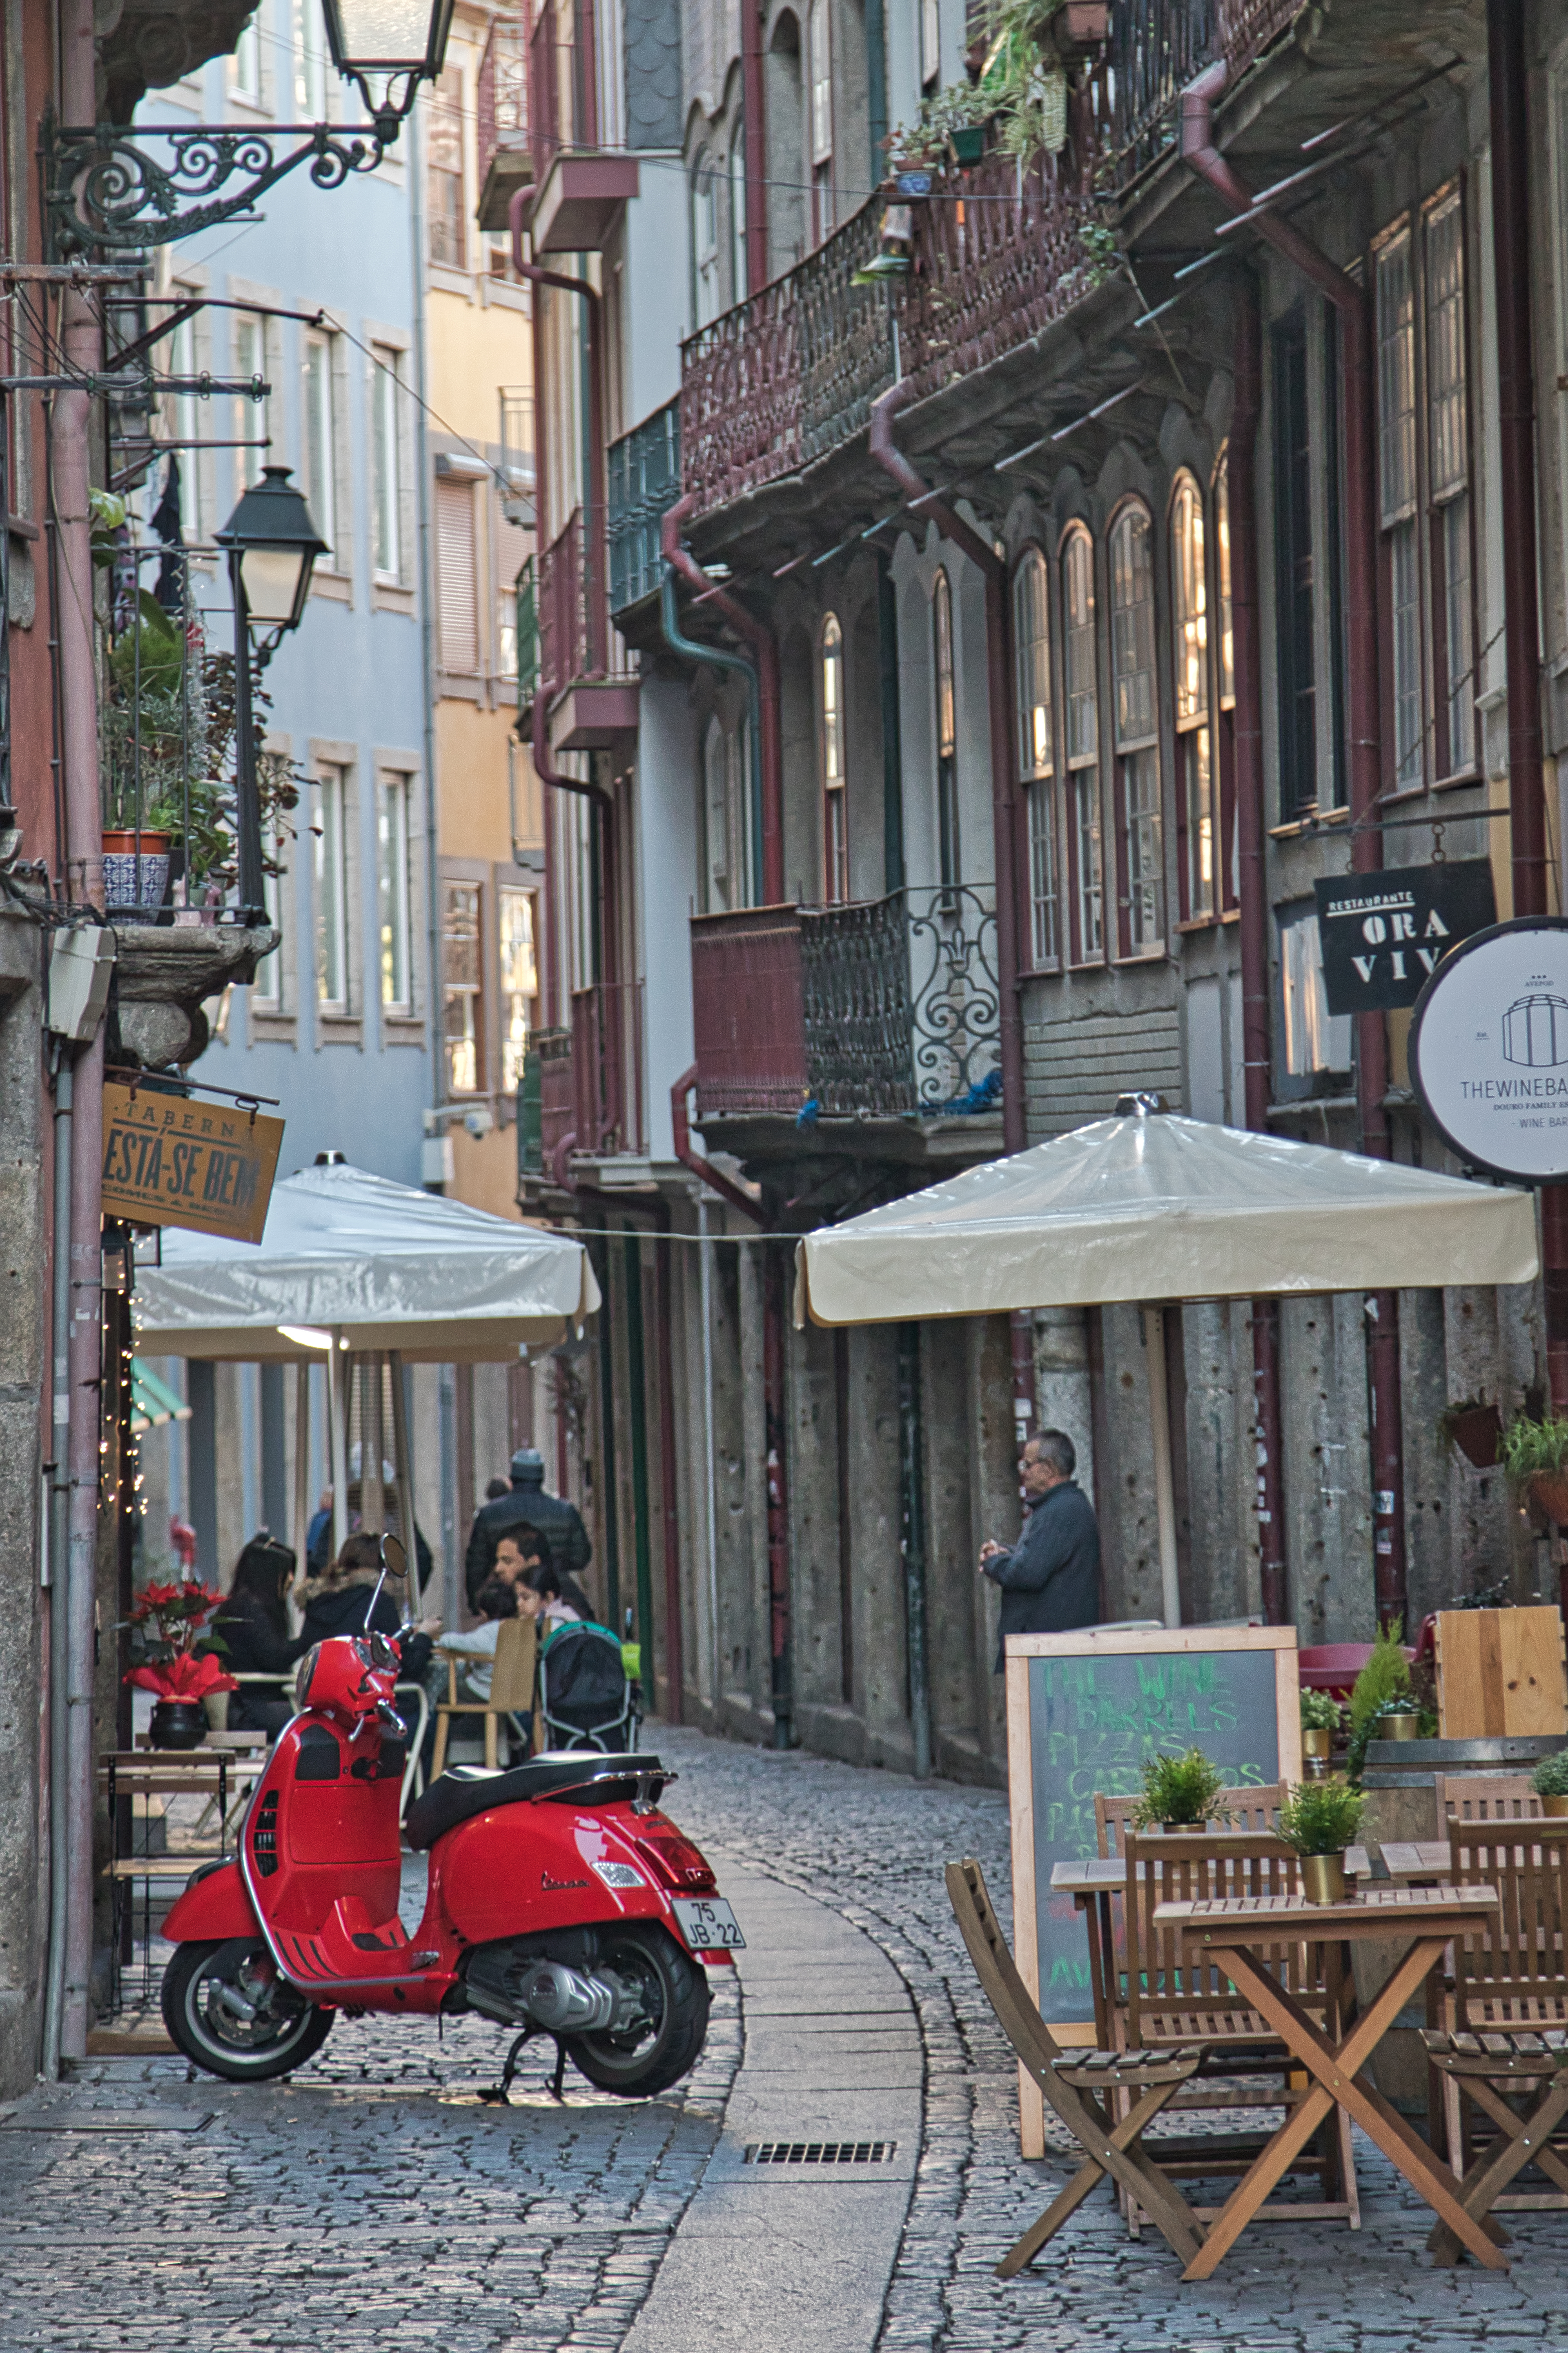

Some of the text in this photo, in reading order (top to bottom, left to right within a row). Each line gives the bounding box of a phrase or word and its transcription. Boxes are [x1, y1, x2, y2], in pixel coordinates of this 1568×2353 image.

[1329, 891, 1414, 911] RESTAURANTE
[1362, 909, 1450, 945] ORA
[1519, 1116, 1568, 1128] WINE BAR
[102, 1126, 203, 1197] ESTÁ-SE
[691, 1902, 715, 1923] 75
